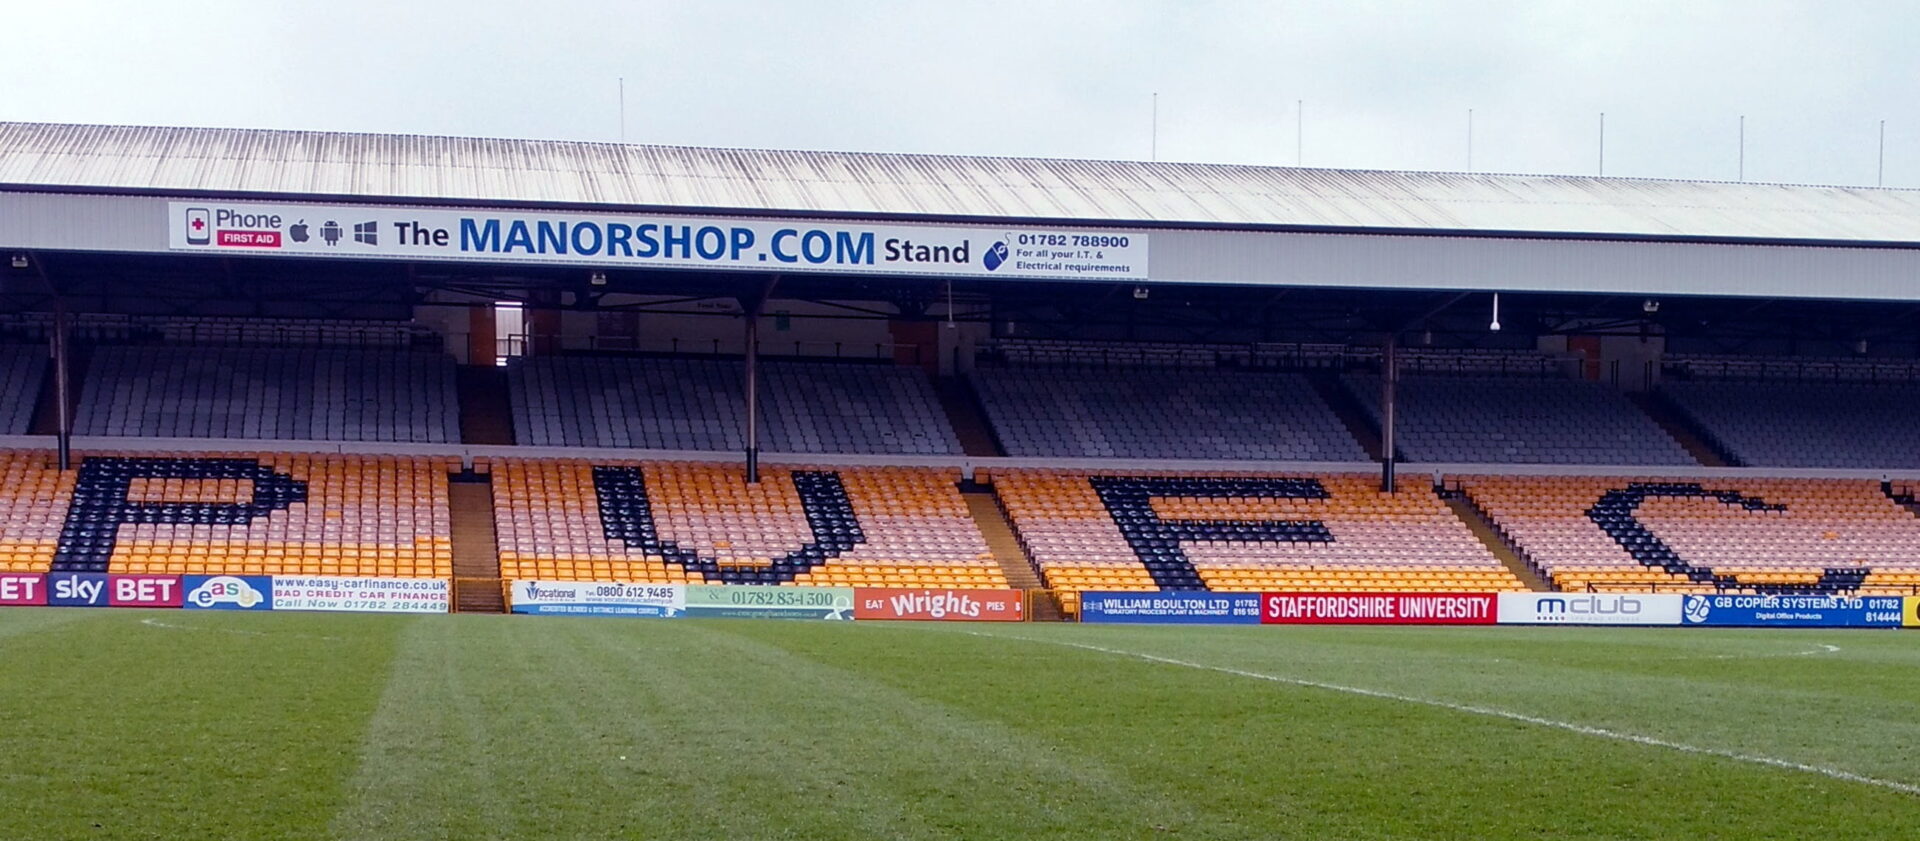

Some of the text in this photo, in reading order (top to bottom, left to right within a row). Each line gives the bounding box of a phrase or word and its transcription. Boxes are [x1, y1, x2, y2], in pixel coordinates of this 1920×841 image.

[216, 209, 282, 230] Phone
[223, 233, 275, 245] FIRST AID
[394, 217, 970, 266] The MANORSHOP.COM Stand
[1018, 233, 1129, 248] 01782 788900
[1016, 249, 1104, 261] For all your I.T. &
[1016, 261, 1131, 273] Electrical requirements
[55, 574, 177, 604] sky BET
[274, 578, 447, 591] www.easy-carfinance.co.uk
[274, 589, 447, 601] BAD CREDIT CAR FINANCE
[596, 586, 623, 598] 0800
[626, 586, 644, 598] 612
[647, 587, 674, 599] 9485
[732, 591, 774, 605] 01782
[274, 598, 447, 611] Call Now 01782 284449
[865, 590, 1006, 618] EAT Wrights PIES
[1103, 599, 1258, 610] WILLIAM BOULTON LTD 01782
[1268, 596, 1491, 619] STAFFORDSHIRE UNIVERSITY
[1714, 597, 1899, 610] GB COPIER SYSTEMS LTD 01782
[1755, 612, 1823, 621] Digital Office Products
[1865, 612, 1901, 622] 814444
